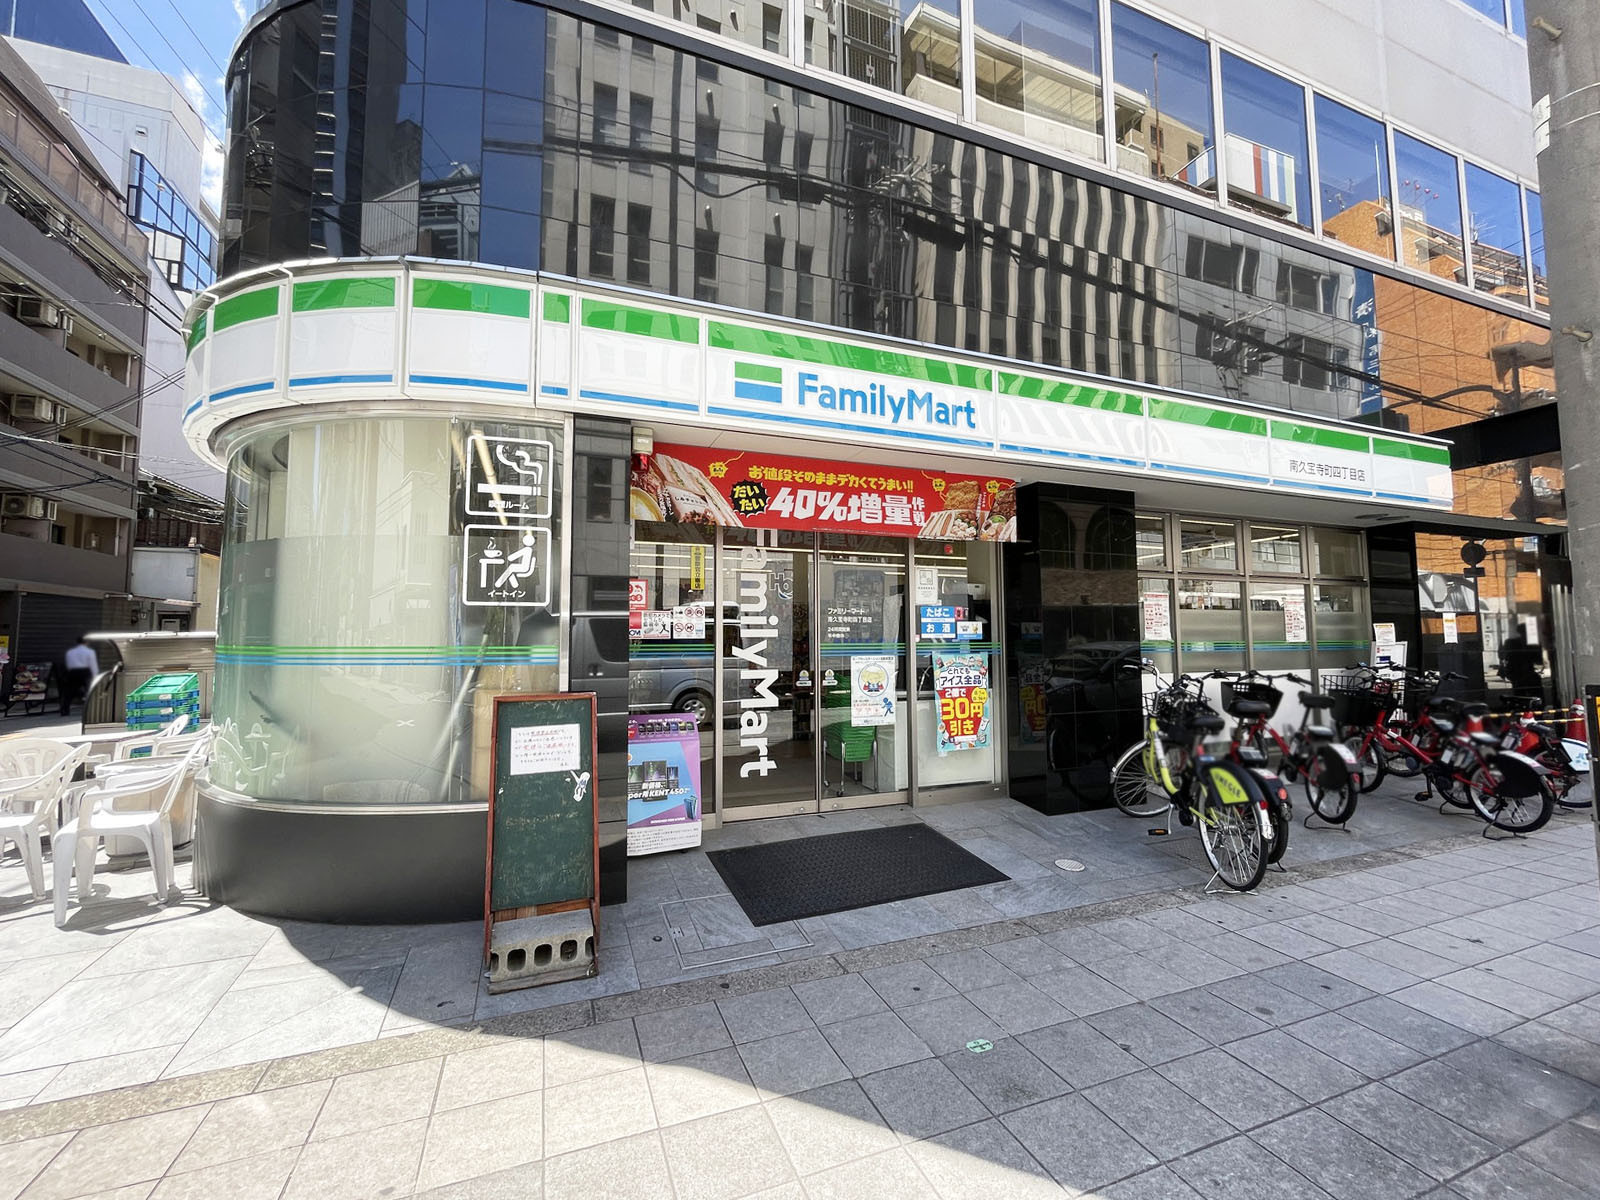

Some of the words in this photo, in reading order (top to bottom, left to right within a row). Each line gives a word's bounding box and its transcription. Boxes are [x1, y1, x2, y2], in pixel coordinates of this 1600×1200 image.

[798, 371, 976, 429] FamilyMart
[1289, 459, 1366, 482] 南久宝寺町四丁目店
[733, 485, 760, 499] だい
[739, 498, 765, 512] たい
[487, 589, 526, 598] イートイン
[926, 607, 950, 618] たばこ
[940, 675, 982, 686] アイス全品
[941, 697, 984, 720] 30円
[949, 720, 974, 736] 引き
